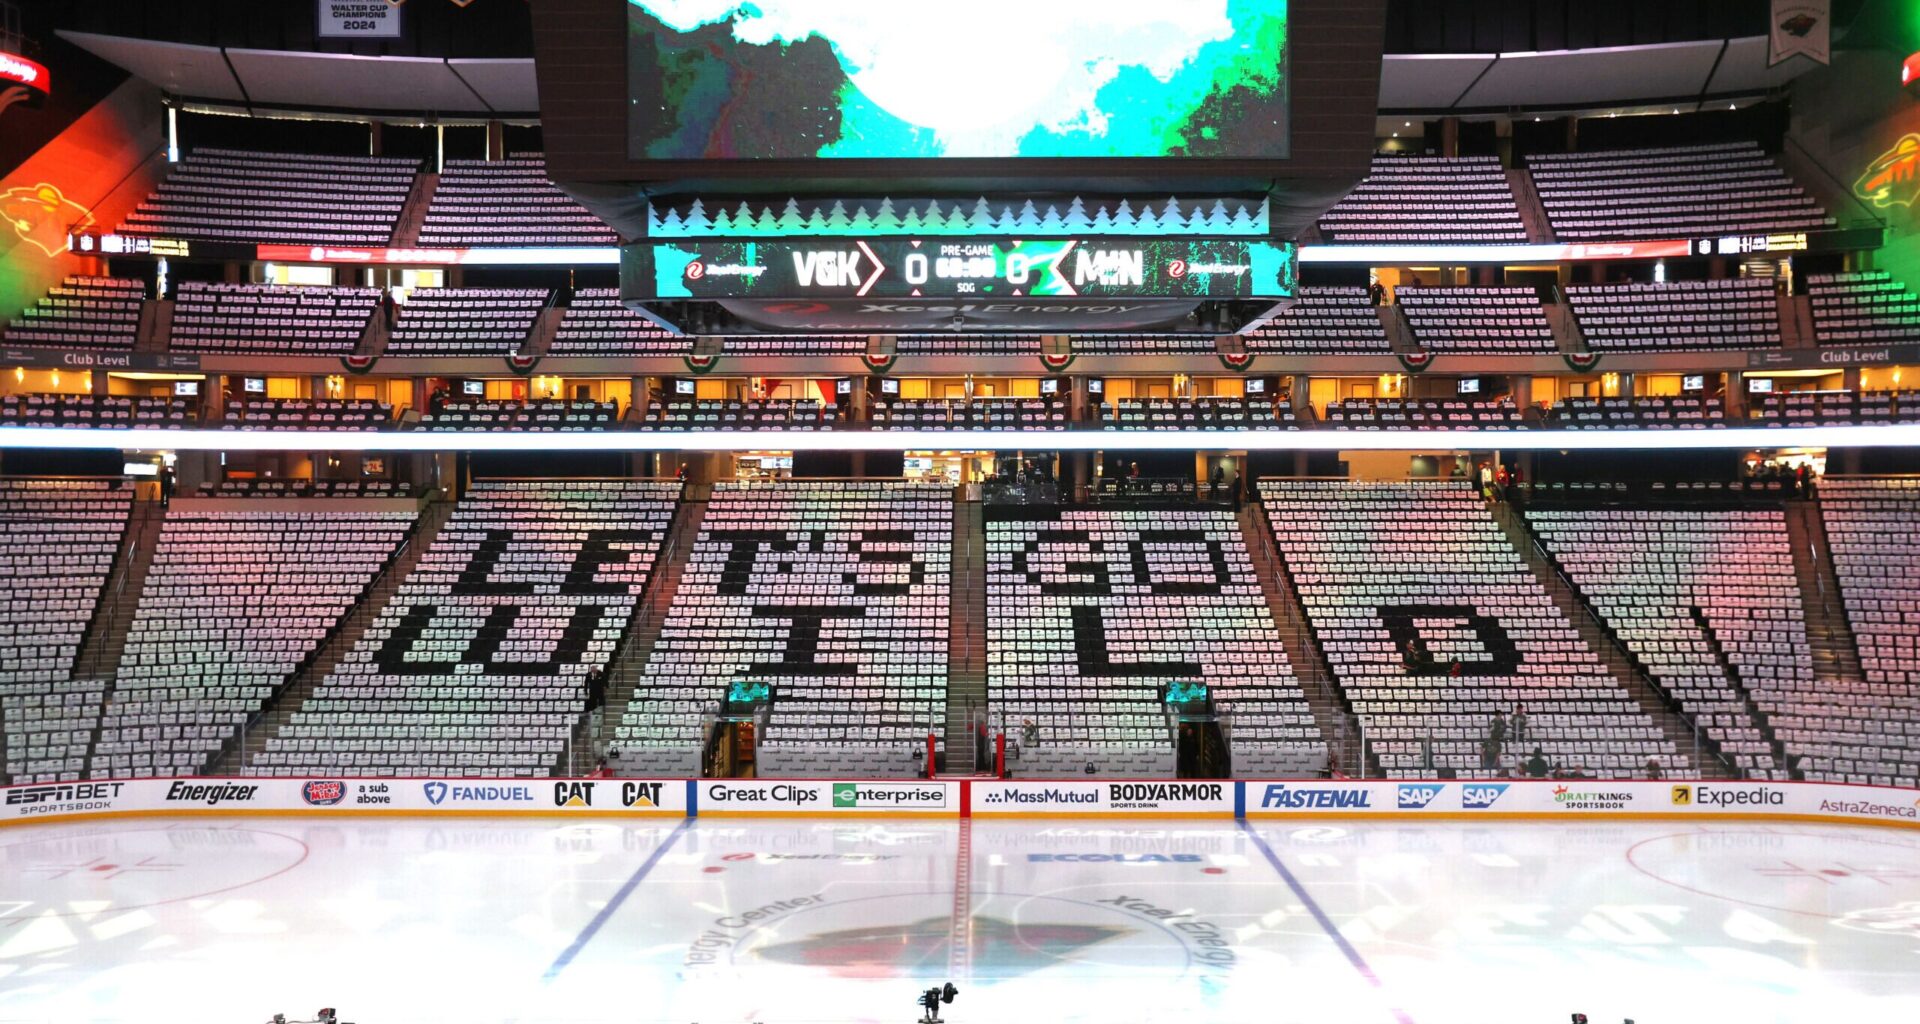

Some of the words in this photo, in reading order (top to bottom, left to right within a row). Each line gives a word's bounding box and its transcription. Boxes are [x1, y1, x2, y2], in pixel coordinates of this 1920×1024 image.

[343, 21, 376, 30] 2024
[940, 245, 994, 256] PRE-GAME
[792, 251, 861, 287] VGK
[905, 253, 928, 285] 0
[1006, 253, 1029, 285] 0
[1075, 250, 1143, 286] MIN
[957, 283, 975, 292] SOG
[856, 304, 977, 313] Xcel
[982, 304, 1140, 314] Energy
[63, 353, 93, 365] Club
[97, 355, 130, 366] Level
[1820, 351, 1850, 363] Club
[1854, 350, 1890, 361] Level
[5, 786, 74, 806] ESPN
[75, 782, 125, 800] BET
[166, 780, 258, 805] Energizer
[359, 785, 365, 793] a
[369, 783, 389, 793] sub
[452, 787, 534, 801] FANDUEL
[554, 781, 595, 807] CAT
[622, 782, 663, 807] CAT
[709, 785, 767, 801] Great
[771, 784, 818, 805] Clips
[838, 788, 943, 804] enterprise
[1004, 788, 1099, 803] MassMutual
[1109, 784, 1223, 801] BODYARMOR
[1261, 784, 1371, 808] FASTENAL
[1398, 788, 1434, 804] SAP
[1463, 788, 1498, 804] SAP
[357, 794, 391, 804] above
[1554, 792, 1633, 802] DRAFTKINGS
[1697, 787, 1784, 808] Expedia
[20, 801, 112, 815] SPORTSBOOK
[1820, 799, 1916, 818] AstraZeneca
[1026, 853, 1203, 863] ECOLAB
[714, 893, 825, 928] Center
[1096, 895, 1193, 919] Xcel
[1173, 921, 1237, 970] Energy
